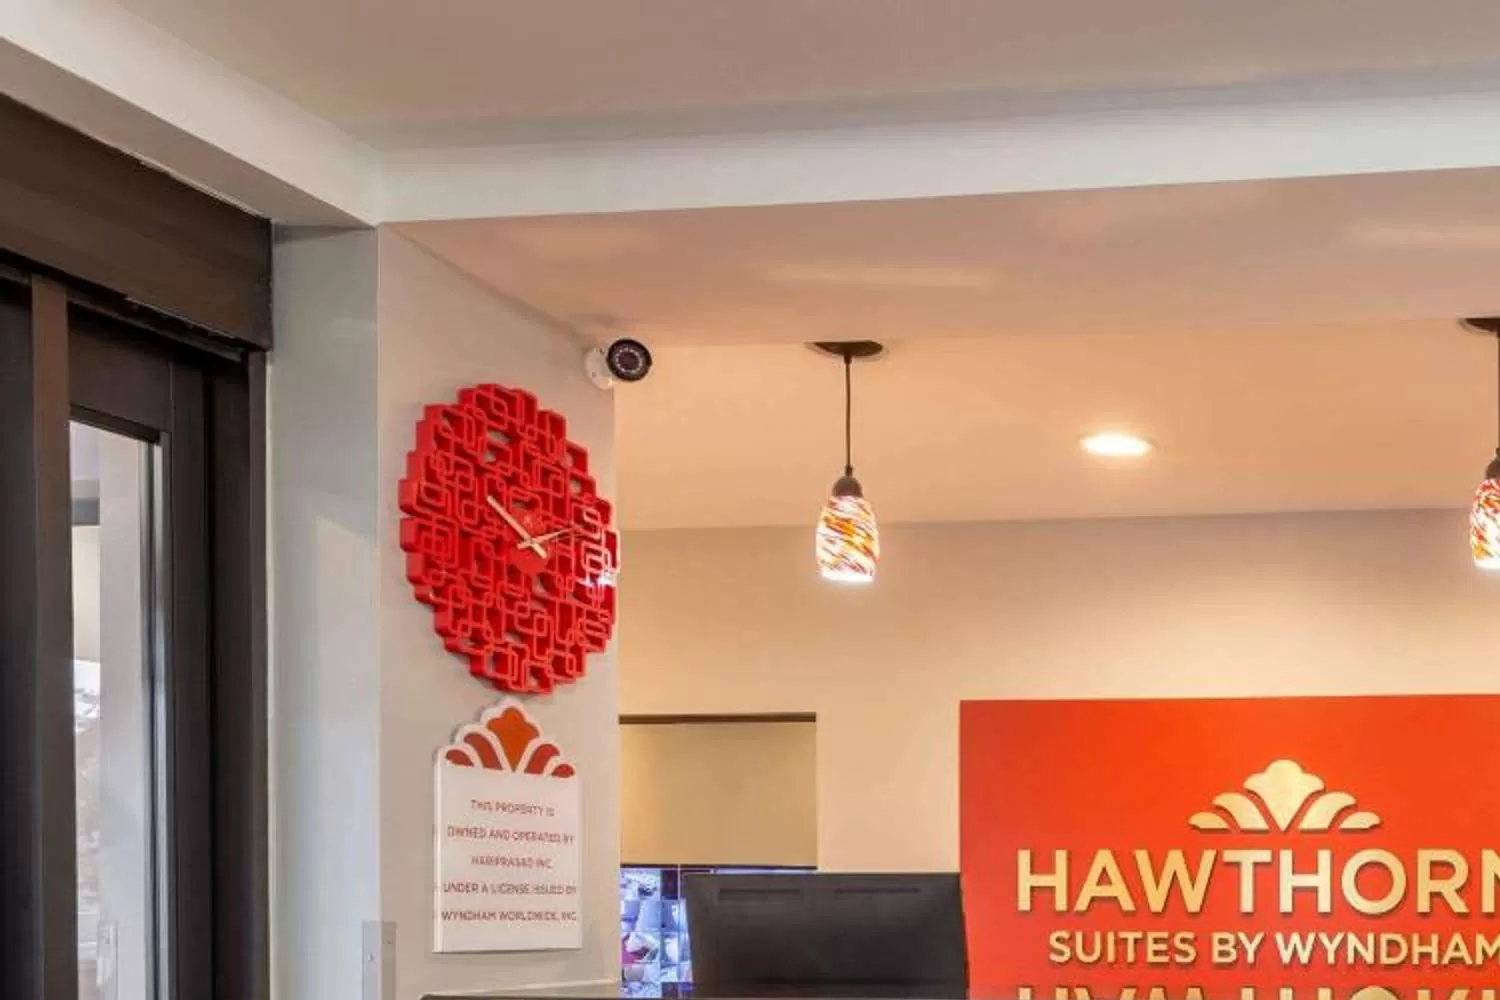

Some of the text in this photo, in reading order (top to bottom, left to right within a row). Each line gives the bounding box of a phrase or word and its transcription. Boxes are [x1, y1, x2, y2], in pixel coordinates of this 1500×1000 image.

[470, 799, 493, 813] THIS
[495, 801, 544, 816] PROPERTY
[447, 825, 574, 845] OWNED AND OPERATED BY
[442, 882, 479, 894] UNDER
[480, 883, 489, 894] A
[490, 883, 529, 895] LICENSE
[441, 910, 497, 922] WYNDHAM
[1048, 930, 1197, 966] SUITES
[1210, 931, 1265, 966] BY
